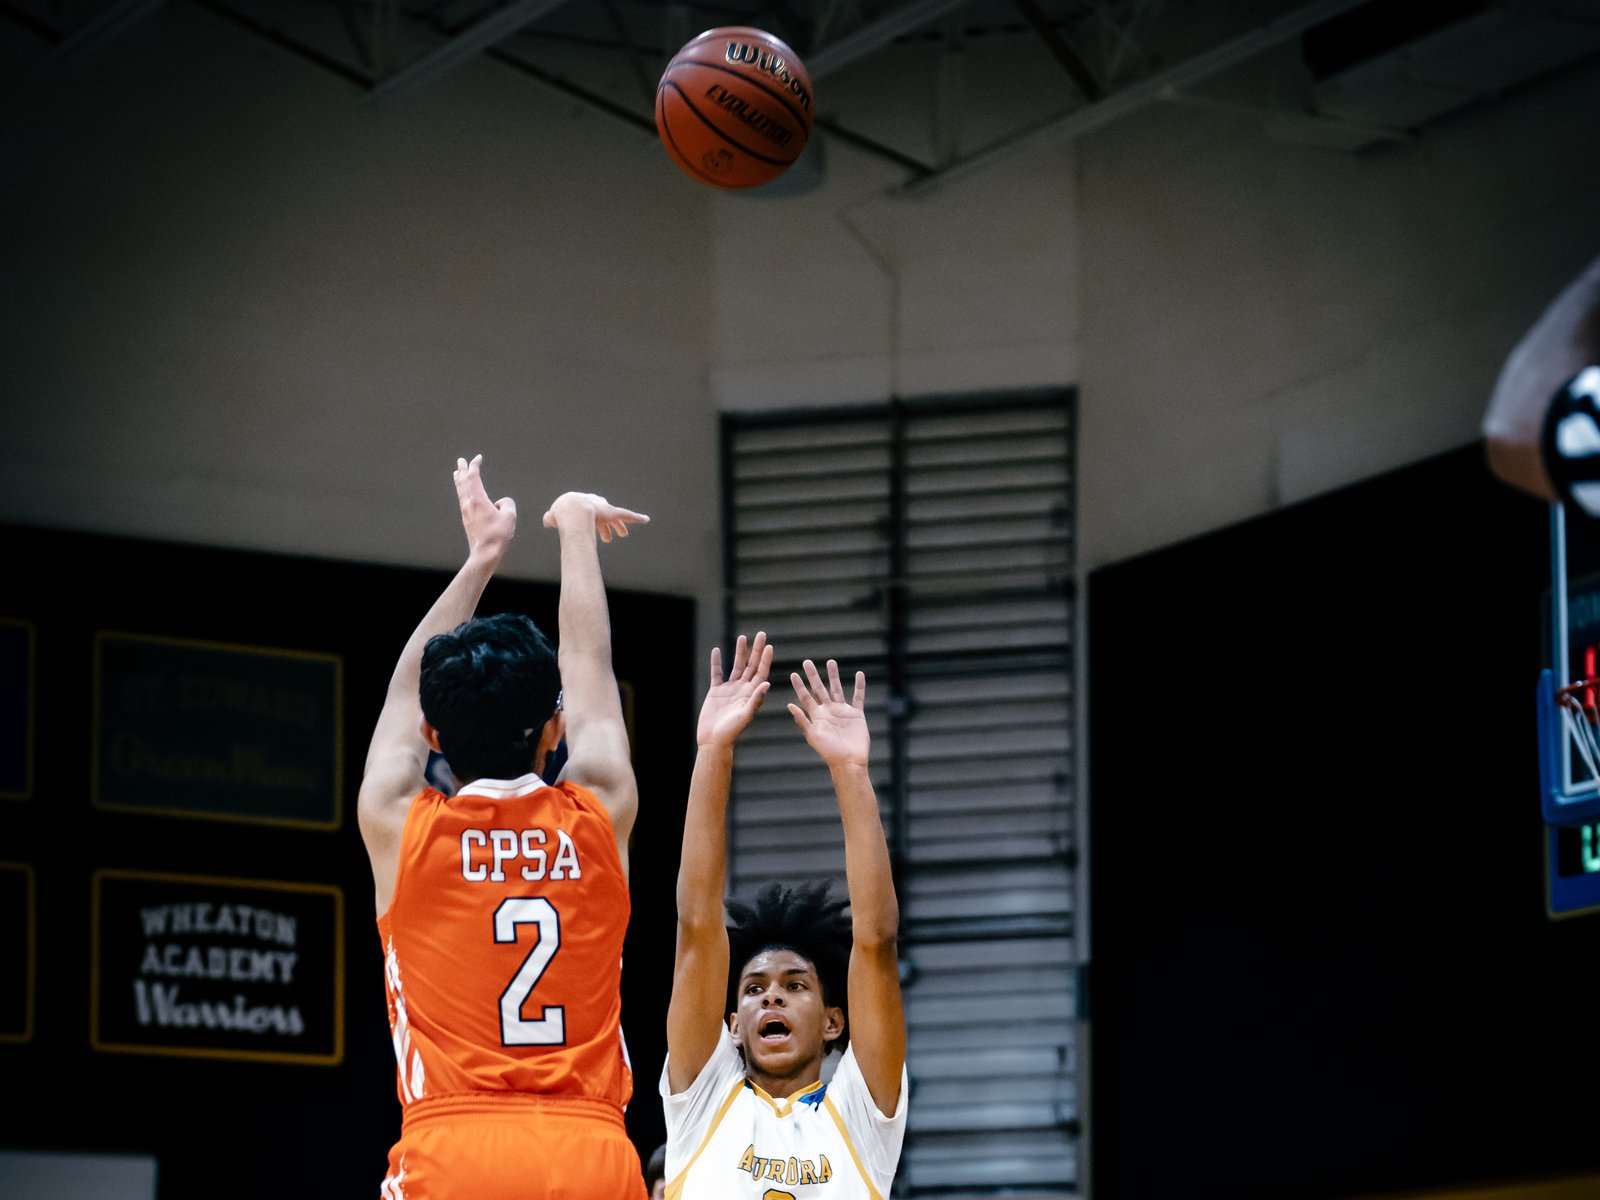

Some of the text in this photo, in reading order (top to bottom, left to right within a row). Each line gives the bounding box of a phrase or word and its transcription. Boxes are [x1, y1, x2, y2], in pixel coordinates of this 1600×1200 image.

[725, 41, 811, 111] Wilson
[705, 84, 793, 147] EVOLUTION
[460, 828, 582, 882] CPSA
[138, 902, 299, 947] WHEATON
[139, 942, 299, 986] ACADEMY
[493, 896, 567, 1047] 2
[132, 976, 307, 1037] Warriors
[737, 1143, 834, 1186] AURORA
